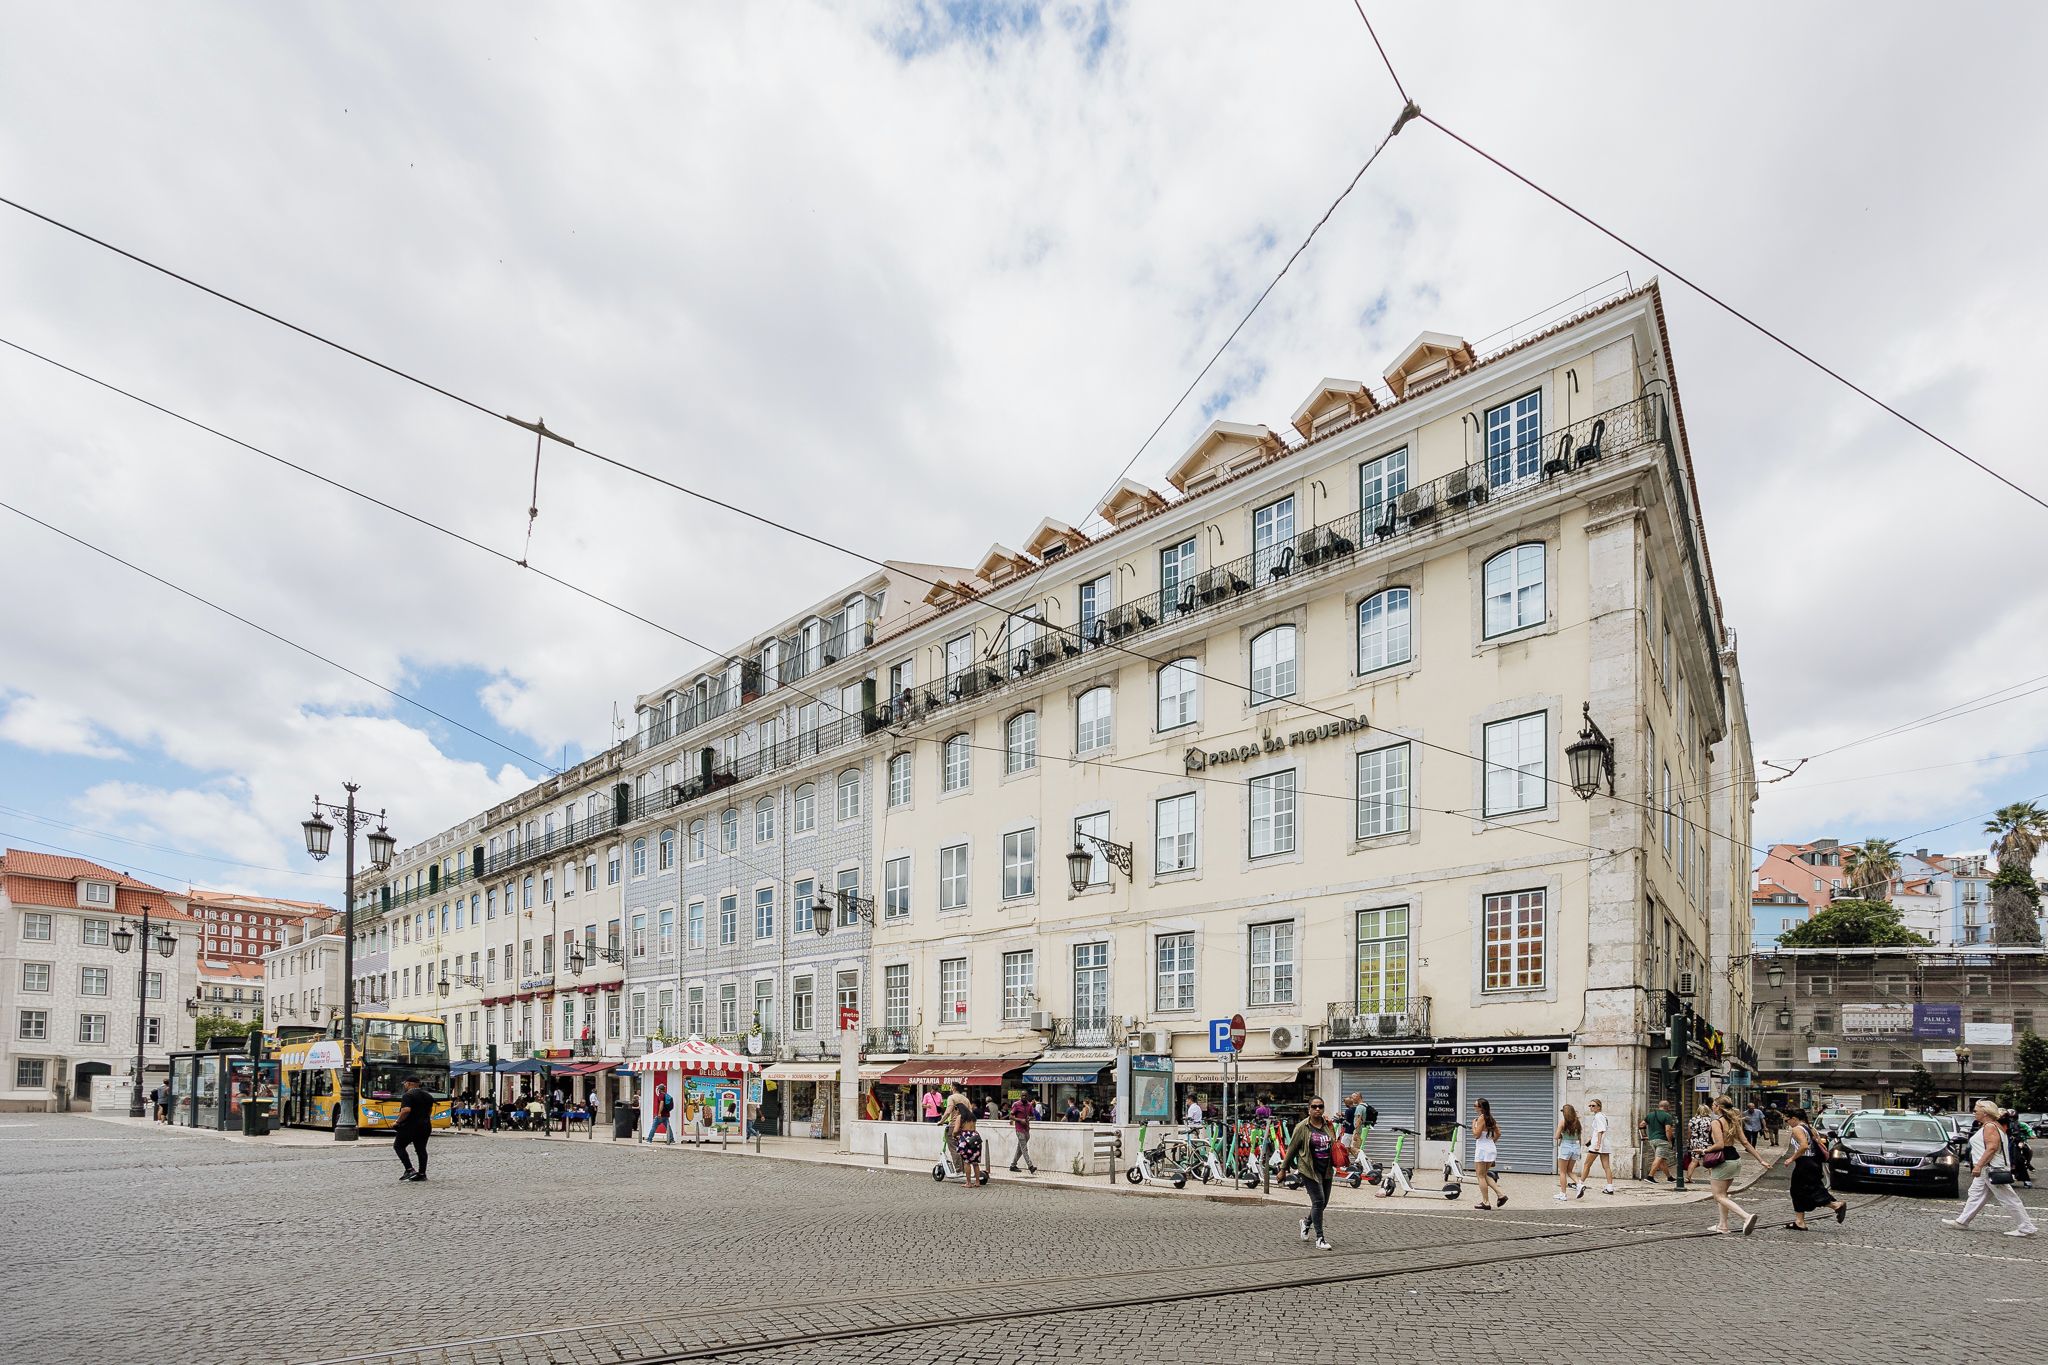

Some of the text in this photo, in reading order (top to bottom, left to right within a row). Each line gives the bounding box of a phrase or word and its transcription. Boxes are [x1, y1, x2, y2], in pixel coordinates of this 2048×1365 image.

[1209, 714, 1370, 767] PRAÇA DA FIGUEIRA
[1215, 1023, 1231, 1050] P
[1331, 1050, 1353, 1058] FIOS
[1370, 1049, 1416, 1057] PASSADO
[1451, 1044, 1550, 1055] FIOS DO PASSADO
[1427, 1070, 1457, 1078] COMPRA
[908, 1077, 940, 1085] SAPATARIA
